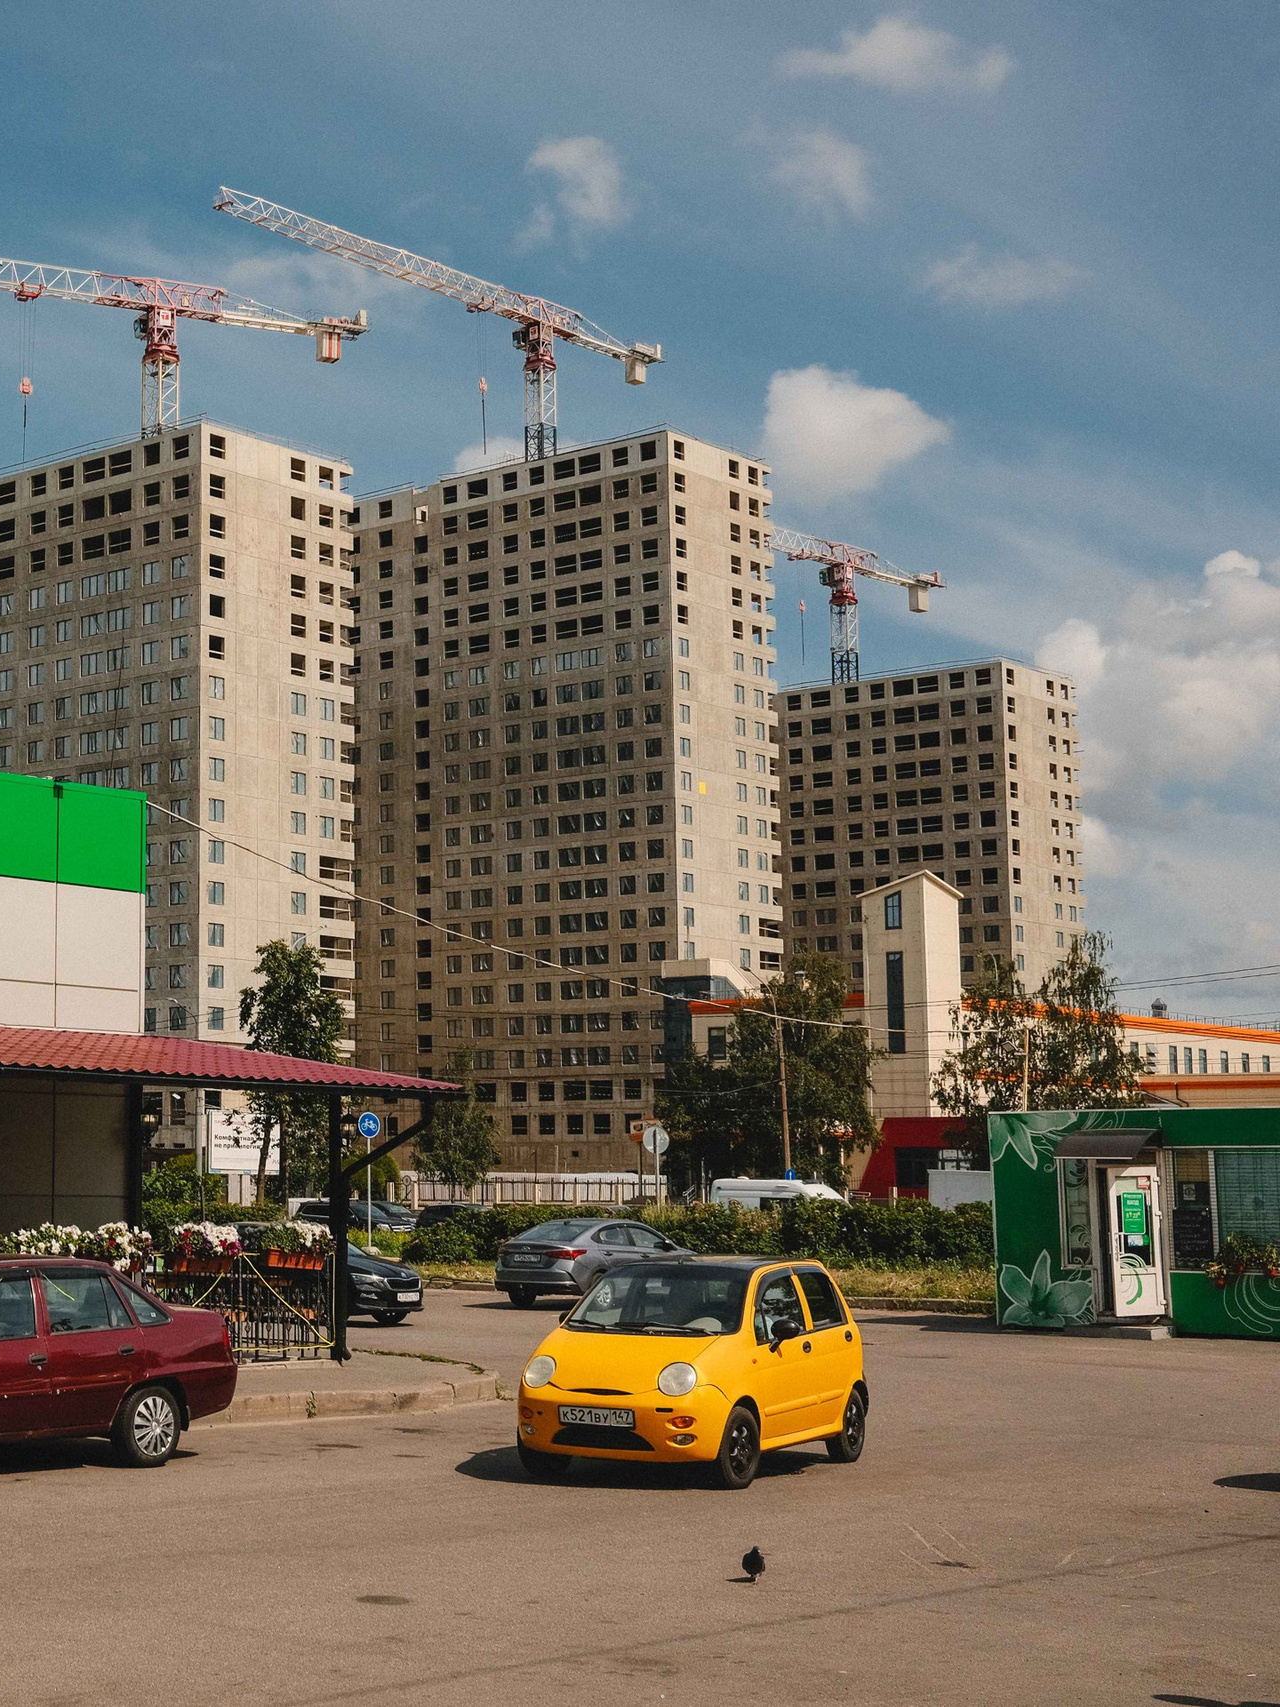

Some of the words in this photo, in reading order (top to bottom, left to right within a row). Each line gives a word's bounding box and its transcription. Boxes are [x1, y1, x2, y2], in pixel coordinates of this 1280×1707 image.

[214, 1134, 254, 1142] Комфтная
[562, 1408, 609, 1423] К521ВУ
[611, 1410, 630, 1423] 147
